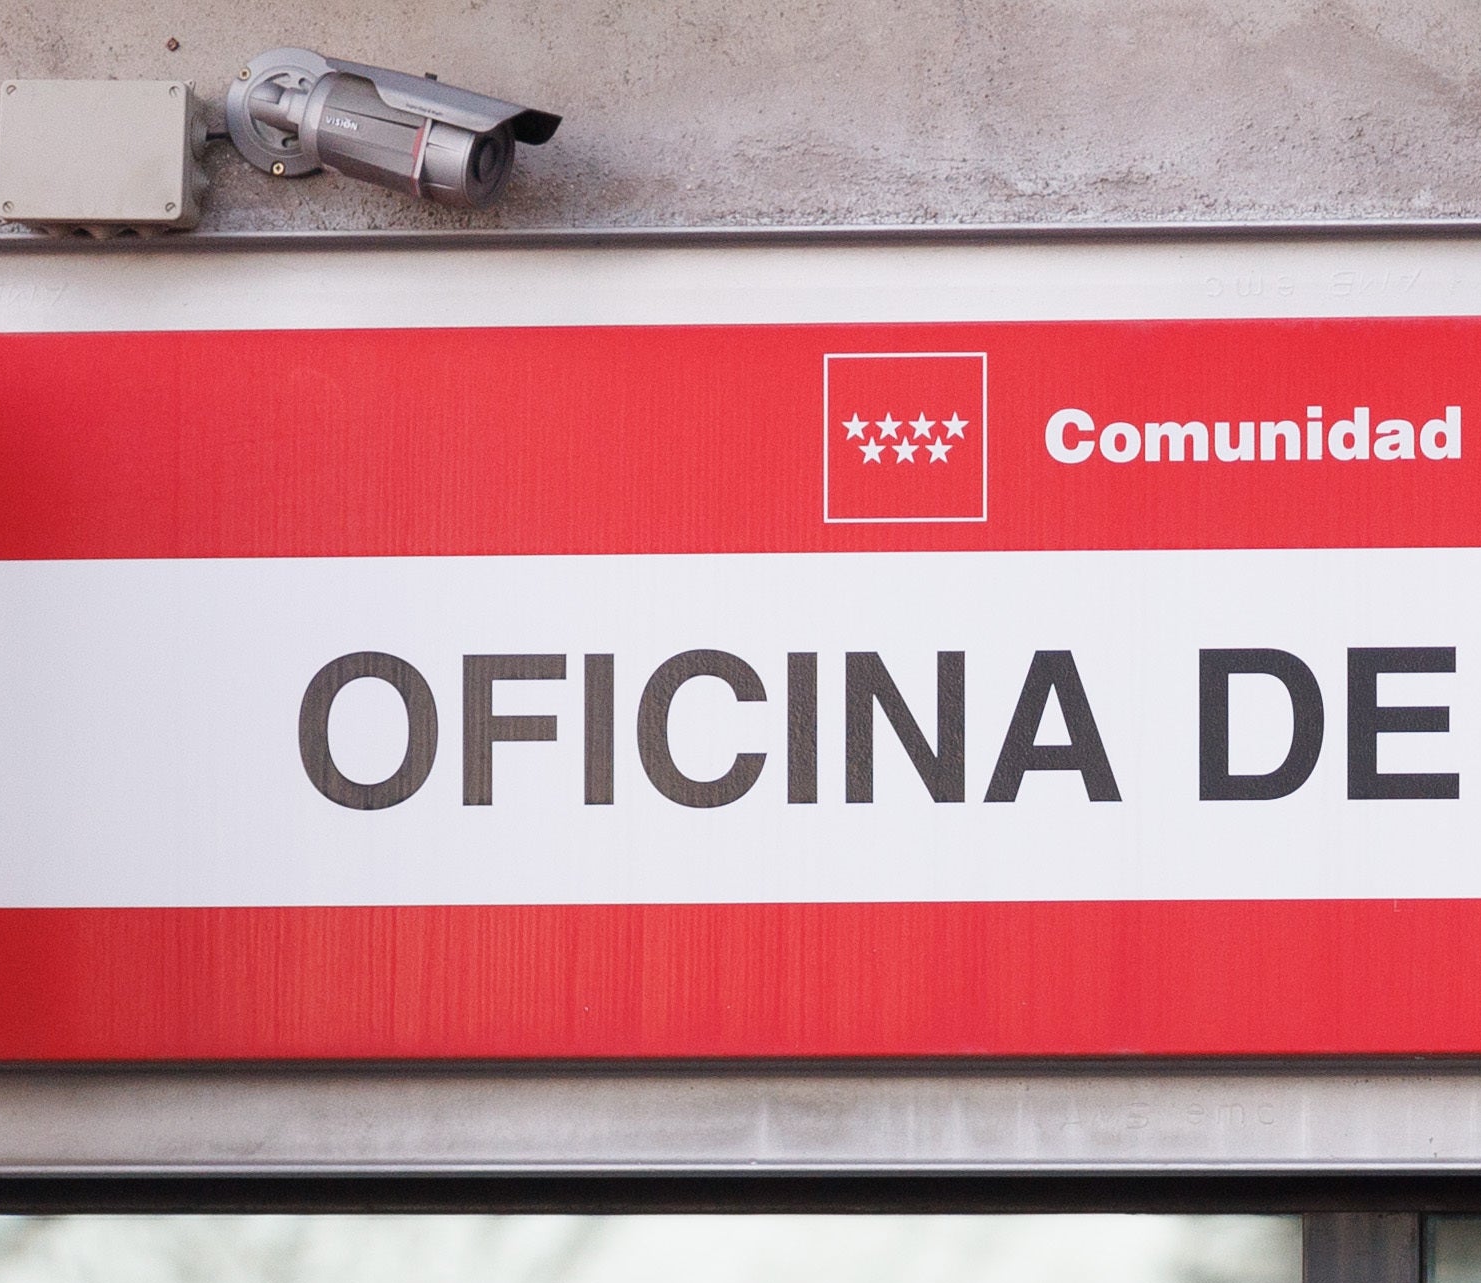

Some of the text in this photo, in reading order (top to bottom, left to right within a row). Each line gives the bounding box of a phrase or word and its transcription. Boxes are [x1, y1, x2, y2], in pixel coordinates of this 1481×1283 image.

[1044, 407, 1463, 465] Comunidad
[294, 647, 1125, 812] OFICINA
[1195, 643, 1464, 801] DE
